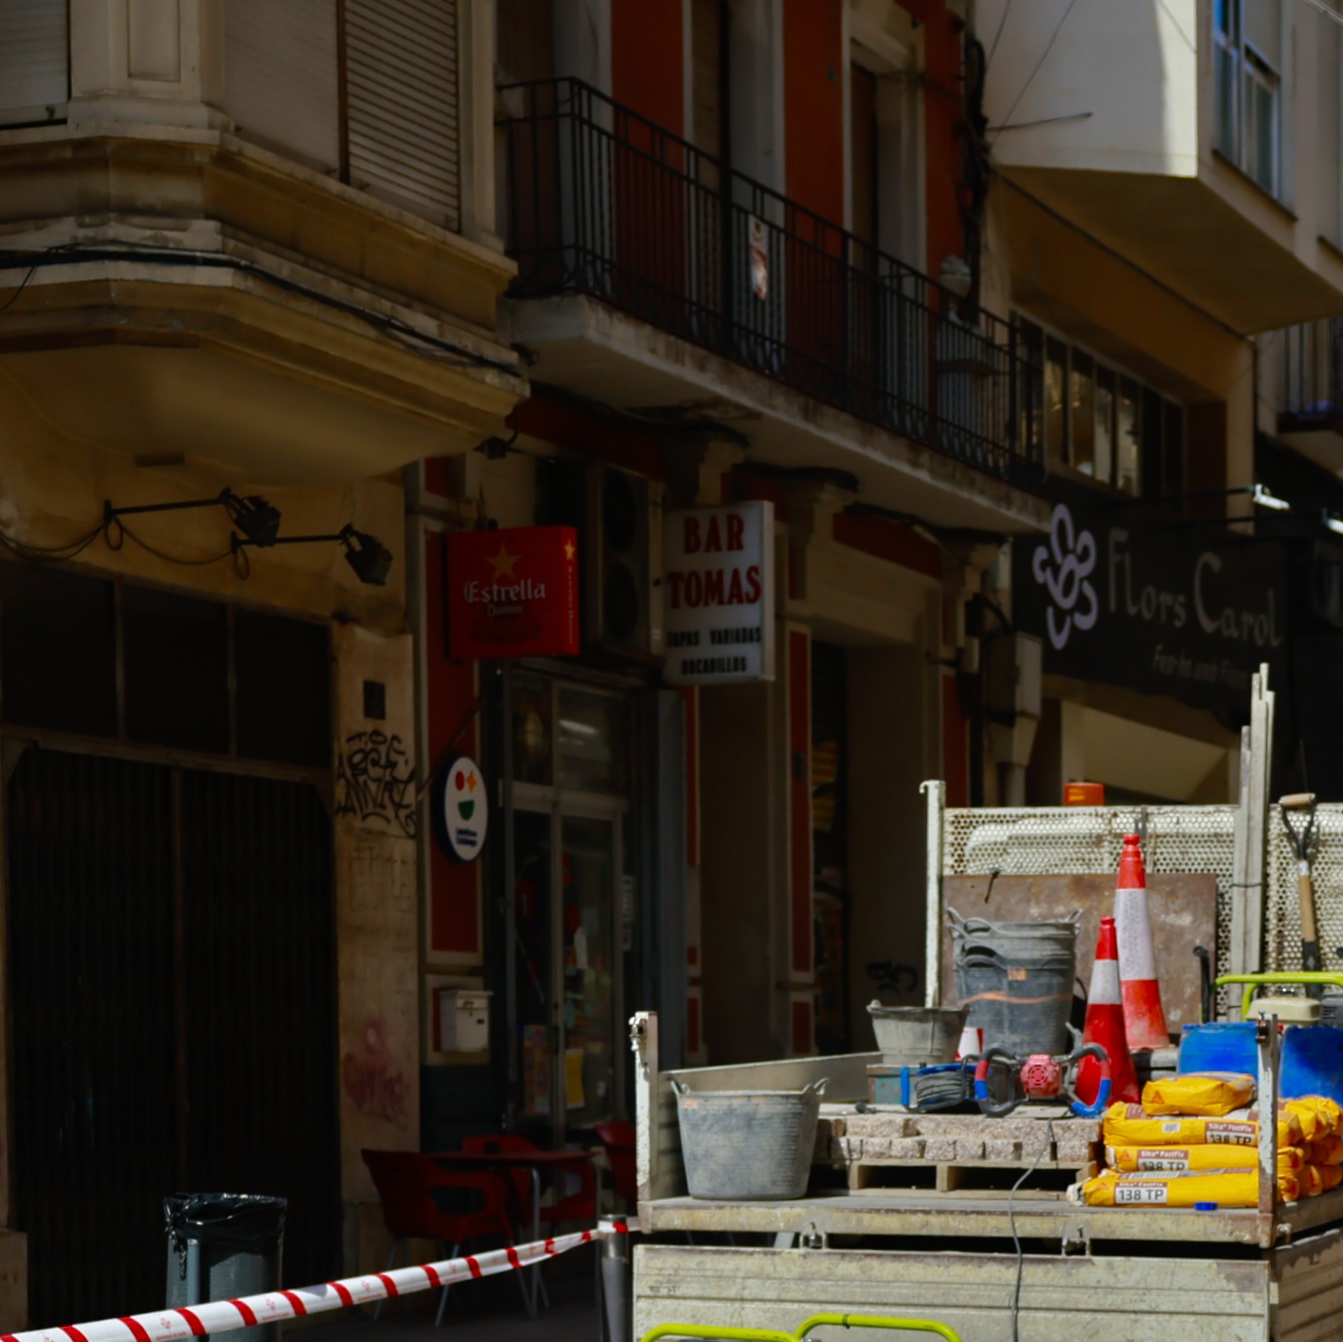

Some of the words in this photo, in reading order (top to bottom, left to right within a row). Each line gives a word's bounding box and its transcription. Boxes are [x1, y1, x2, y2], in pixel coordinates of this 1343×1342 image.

[684, 513, 744, 553] BAR
[463, 577, 546, 604] Estrella
[666, 565, 761, 609] TOMAS
[1109, 526, 1187, 628] Flors
[1194, 551, 1283, 648] Carol
[667, 631, 700, 647] TAPAS
[710, 627, 762, 646] VARIADAS
[1233, 1134, 1253, 1146] TP
[1167, 1161, 1186, 1171] TP
[1118, 1188, 1142, 1201] 138
[1145, 1188, 1164, 1201] TP
